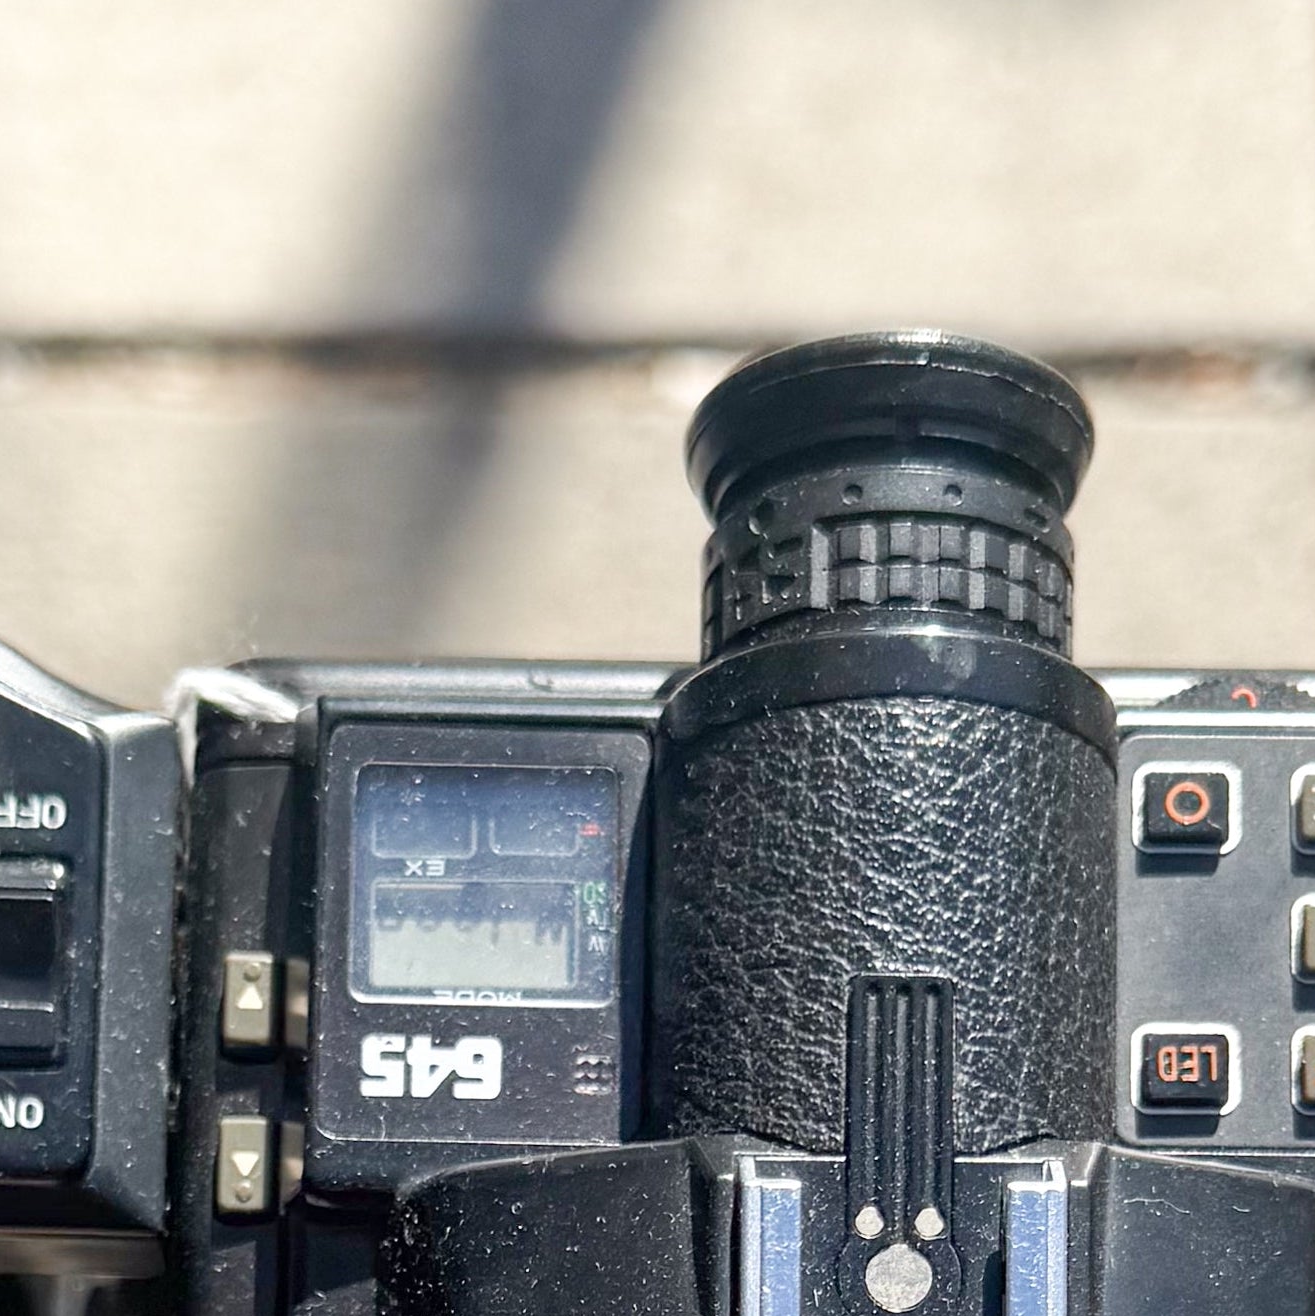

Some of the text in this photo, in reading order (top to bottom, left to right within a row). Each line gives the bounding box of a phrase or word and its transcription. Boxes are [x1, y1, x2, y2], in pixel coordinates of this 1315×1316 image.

[405, 860, 445, 876] EX
[361, 1034, 502, 1099] 645
[1158, 1046, 1217, 1081] LED
